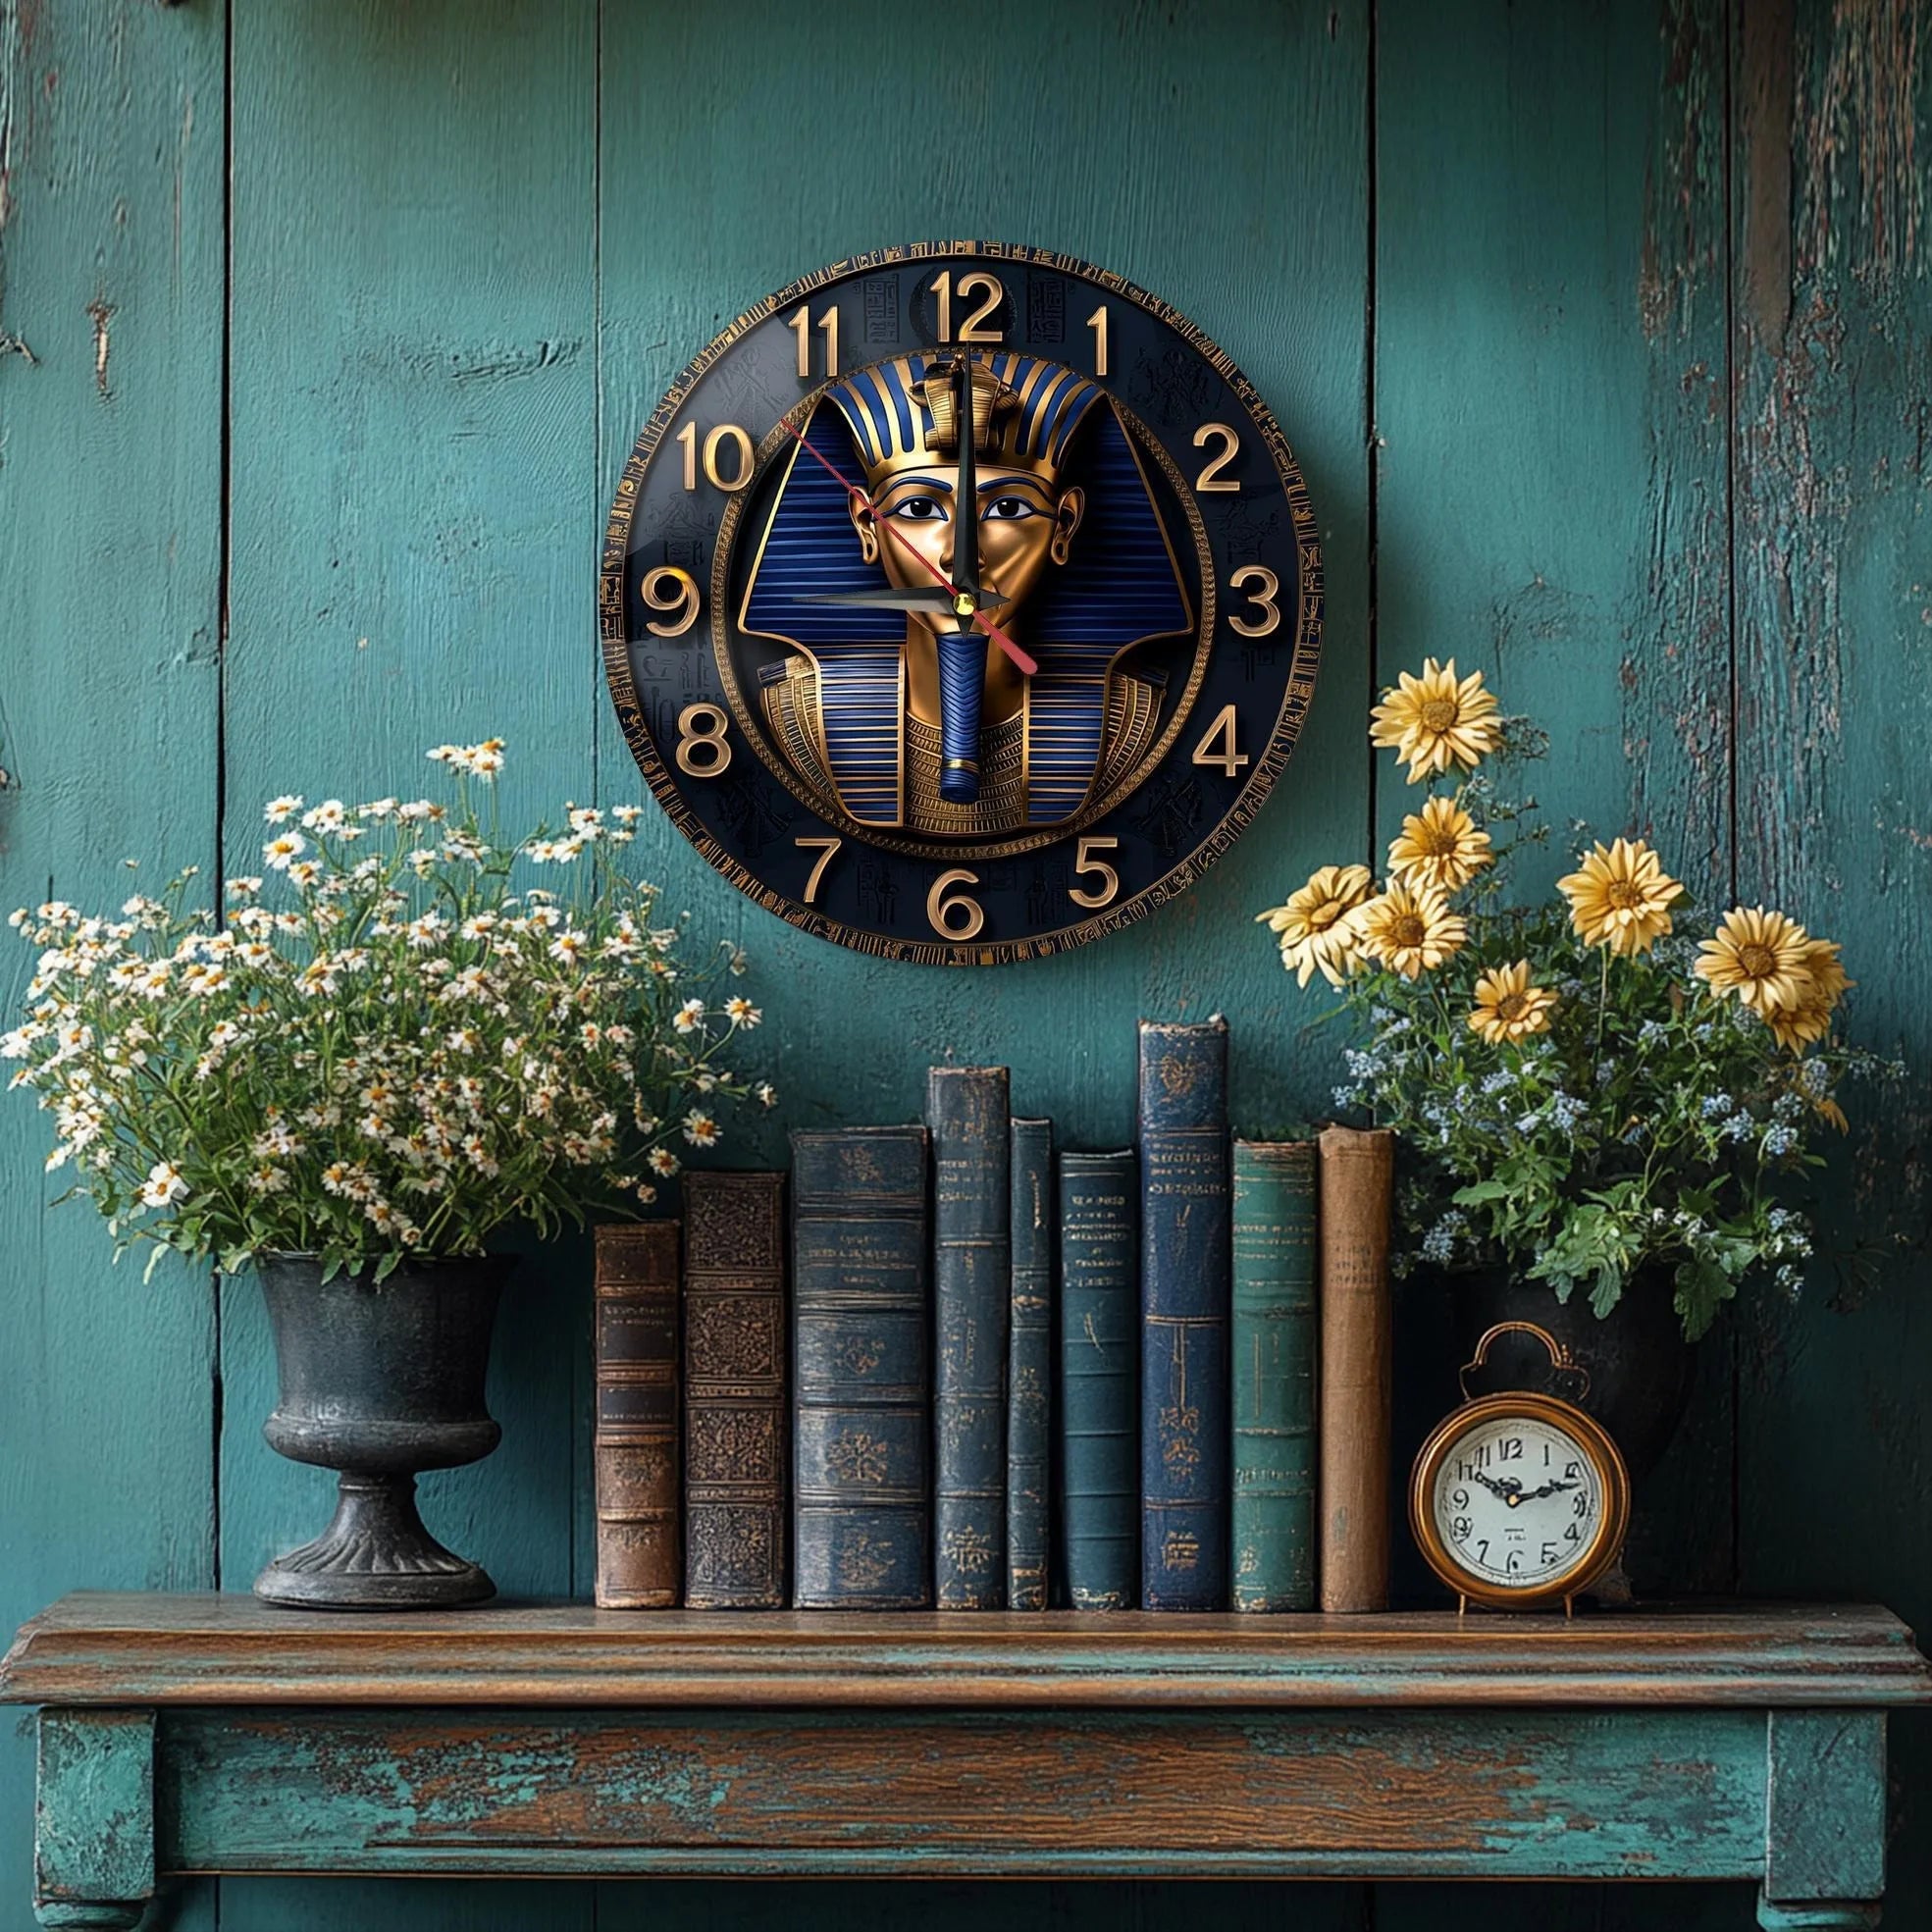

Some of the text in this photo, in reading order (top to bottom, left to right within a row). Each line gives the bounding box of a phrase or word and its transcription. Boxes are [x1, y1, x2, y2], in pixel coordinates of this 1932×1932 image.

[789, 305, 839, 377] 11
[931, 271, 1004, 342] 12
[1088, 305, 1107, 377] 1
[676, 422, 756, 492] 10
[1193, 423, 1240, 492] 2
[641, 566, 700, 637] 9
[1228, 566, 1280, 637] 3
[675, 704, 731, 777] 8
[1192, 705, 1249, 777] 4
[795, 837, 842, 904] 7
[926, 868, 984, 941] 6
[1069, 837, 1119, 908] 5
[1476, 1446, 1490, 1467] 11
[1499, 1437, 1523, 1460] 12
[1544, 1444, 1549, 1466] 1
[1453, 1488, 1469, 1510] 9
[1477, 1540, 1489, 1564] 7
